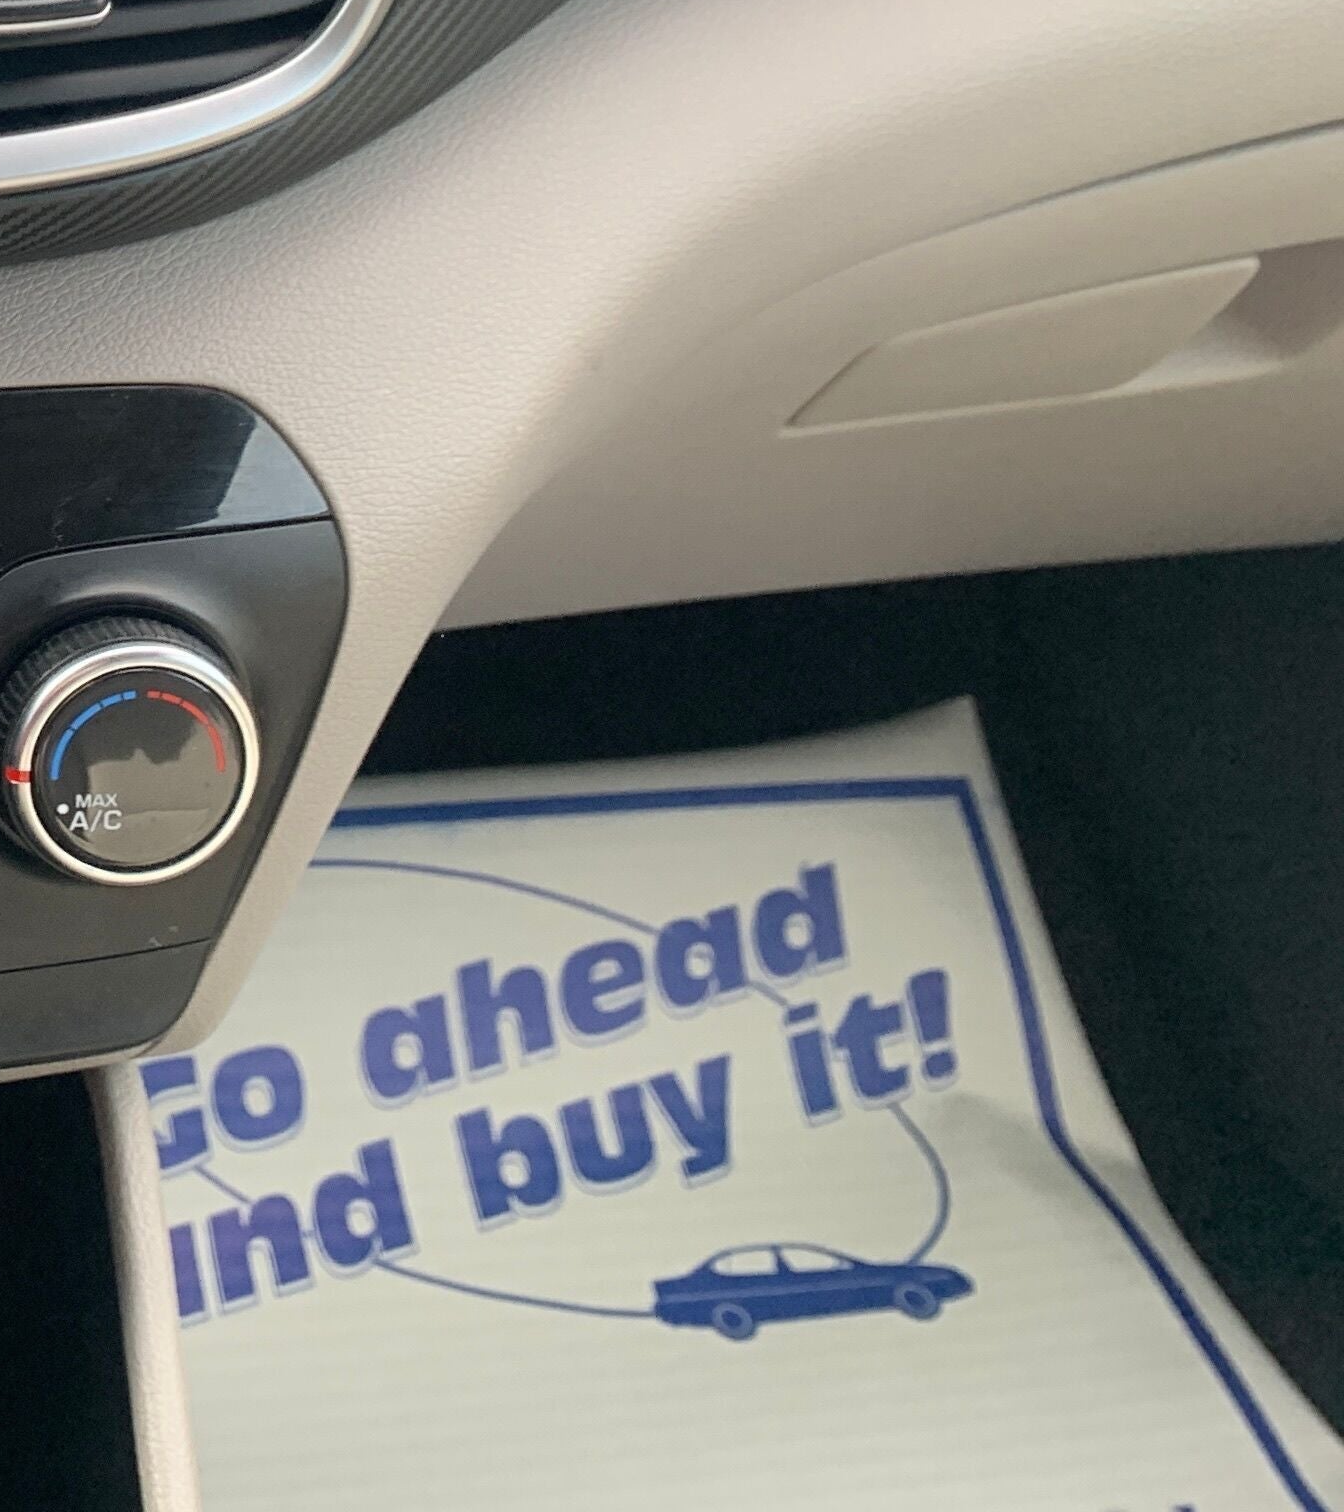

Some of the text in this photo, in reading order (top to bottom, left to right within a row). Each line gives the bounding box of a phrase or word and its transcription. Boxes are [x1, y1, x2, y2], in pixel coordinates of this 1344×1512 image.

[69, 810, 123, 831] A/C
[76, 794, 117, 808] MAX
[361, 859, 848, 1101] ahead
[455, 1053, 732, 1228] buy
[783, 968, 958, 1126] it!
